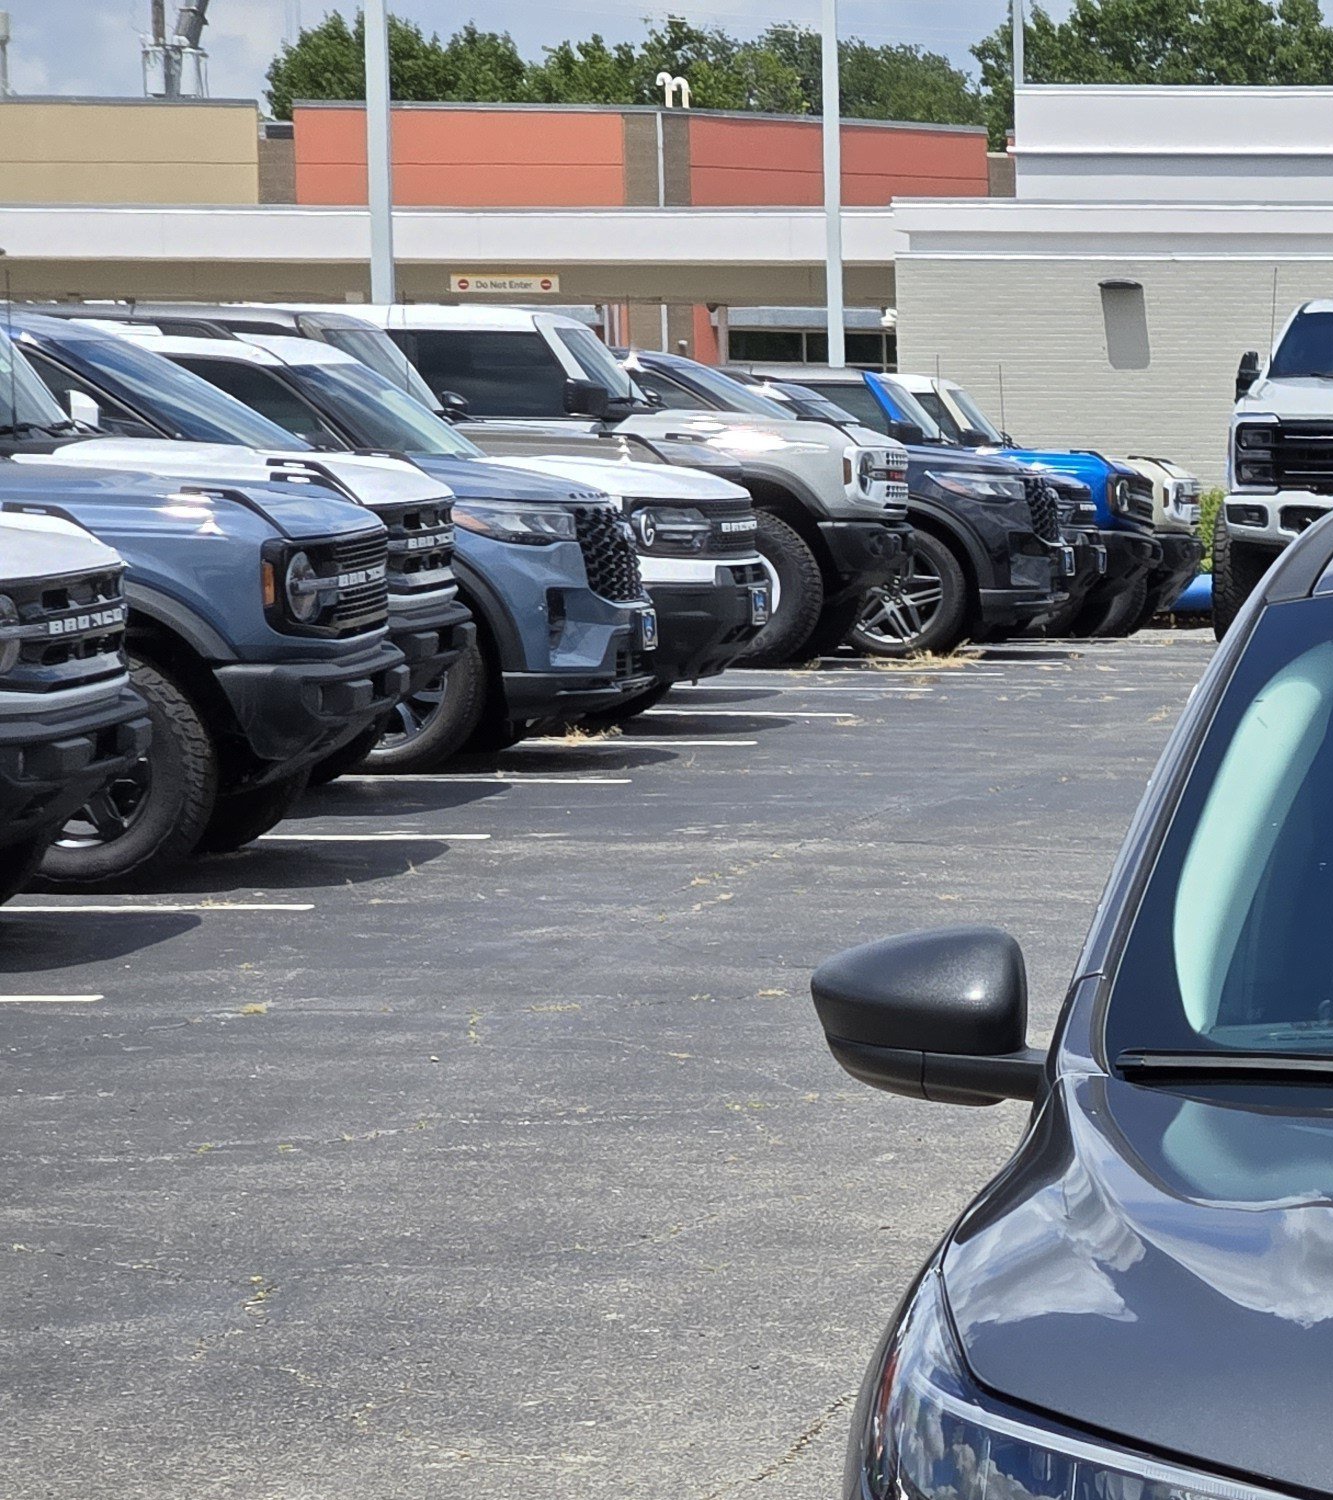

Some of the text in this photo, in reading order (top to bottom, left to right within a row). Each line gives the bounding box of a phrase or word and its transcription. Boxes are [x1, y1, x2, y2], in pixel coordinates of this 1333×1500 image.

[475, 280, 533, 289] Do Not Enter
